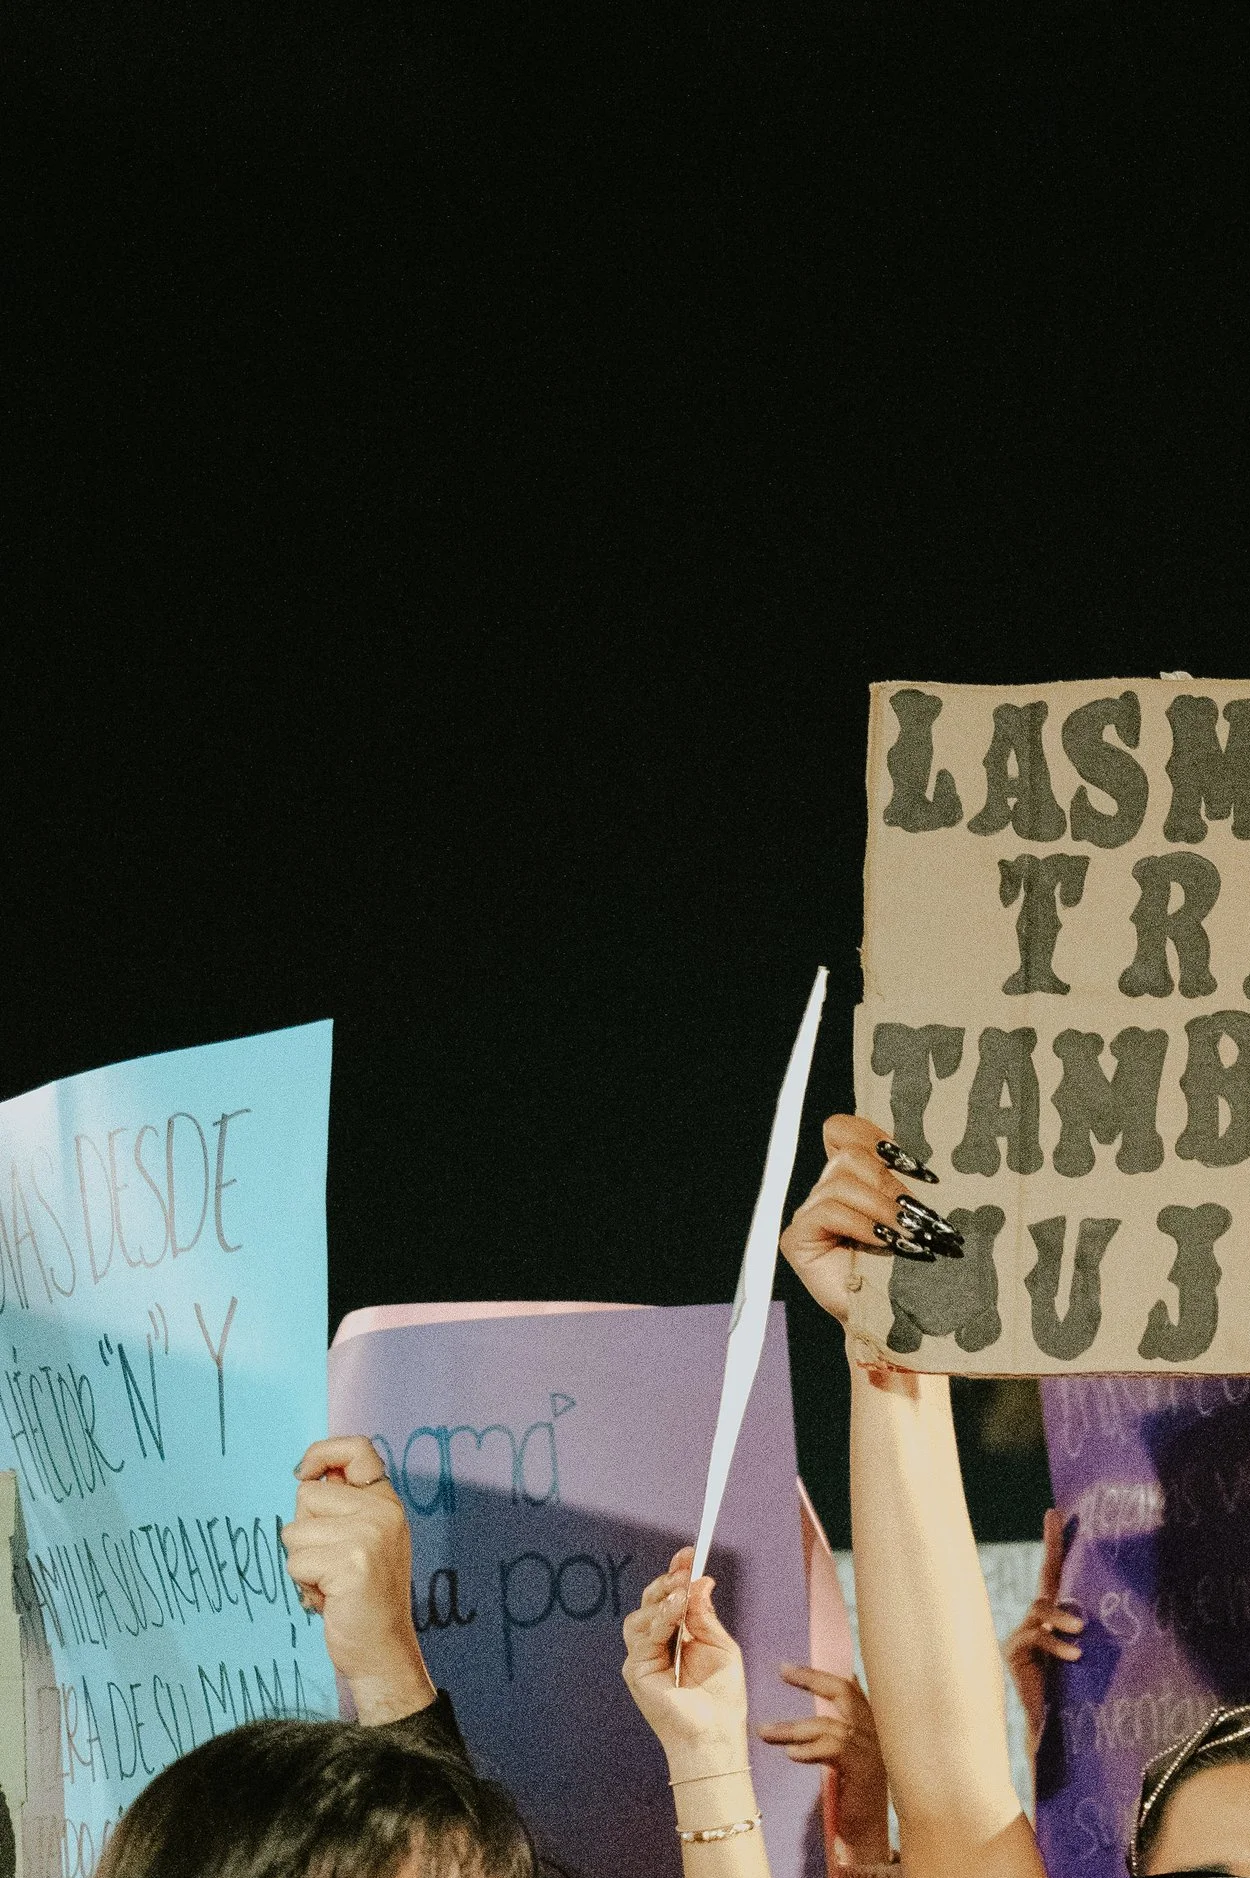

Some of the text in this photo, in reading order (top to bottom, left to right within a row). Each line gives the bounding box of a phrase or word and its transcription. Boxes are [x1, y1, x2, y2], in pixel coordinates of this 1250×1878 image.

[883, 688, 1149, 849] LAS
[75, 1108, 251, 1285] DESDE
[193, 1296, 239, 1457] Y
[500, 1551, 634, 1684] por
